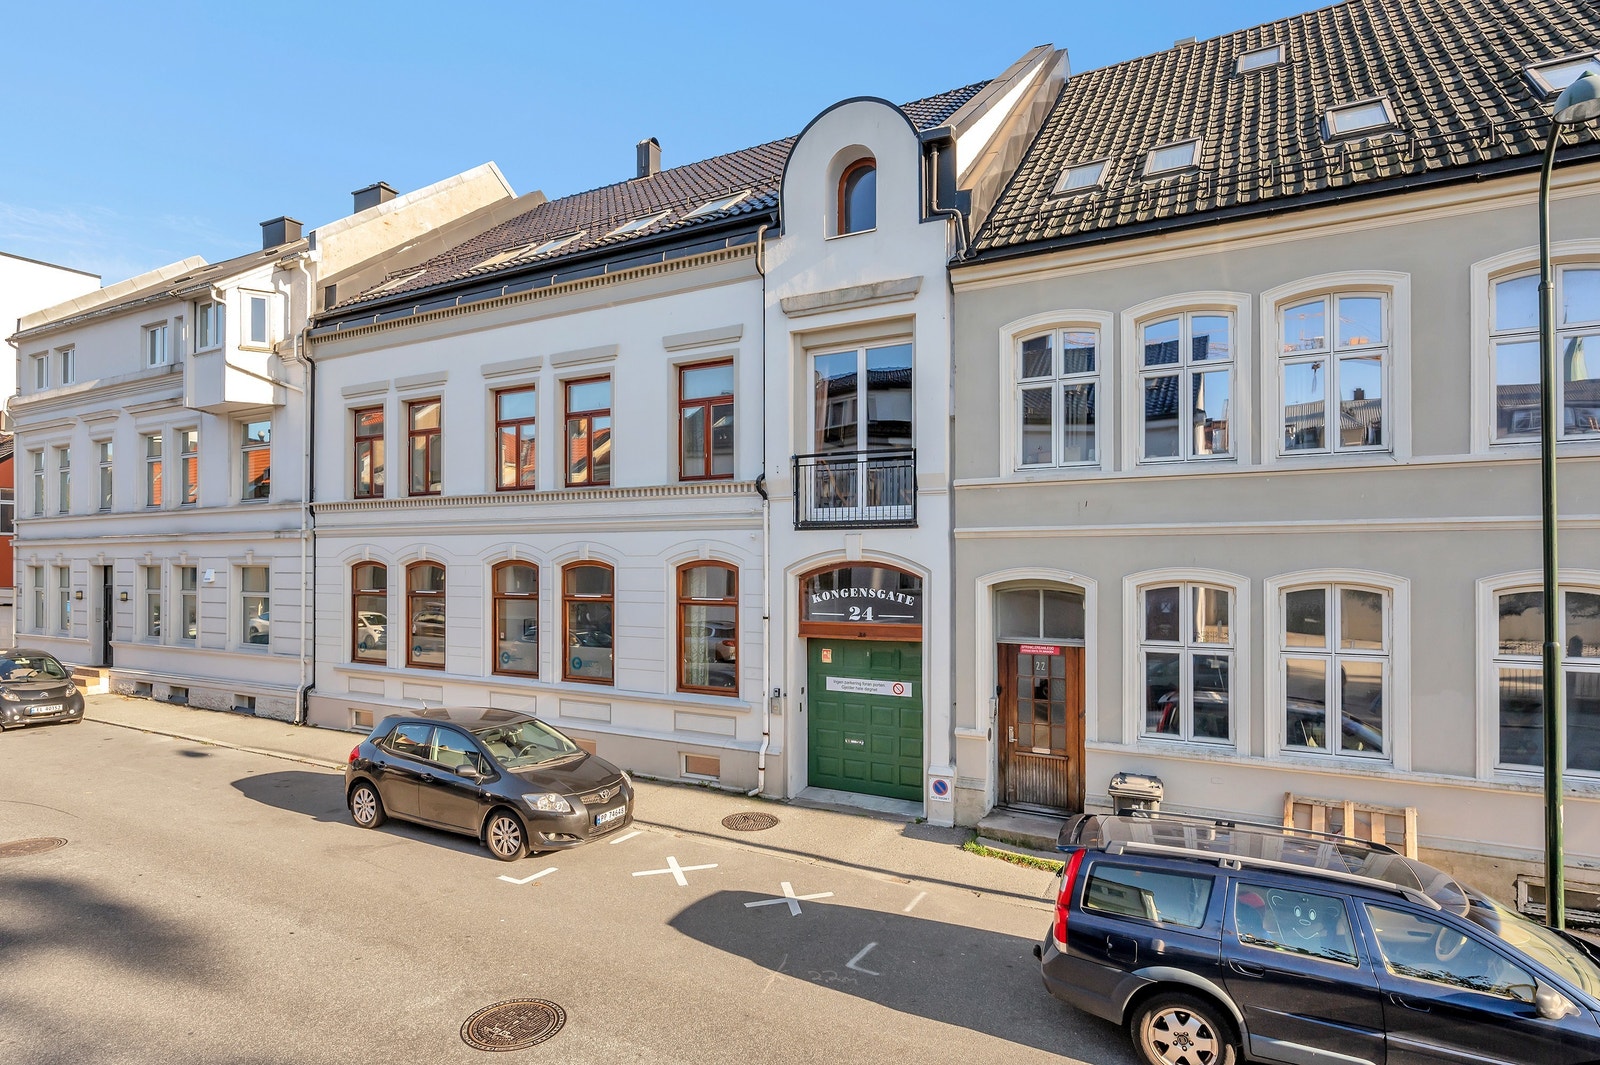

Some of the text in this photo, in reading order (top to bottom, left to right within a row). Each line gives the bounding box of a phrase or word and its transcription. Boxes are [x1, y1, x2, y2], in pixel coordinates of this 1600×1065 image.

[811, 587, 915, 607] KONGENSGATE
[848, 605, 874, 621] 24
[1035, 661, 1046, 671] 22
